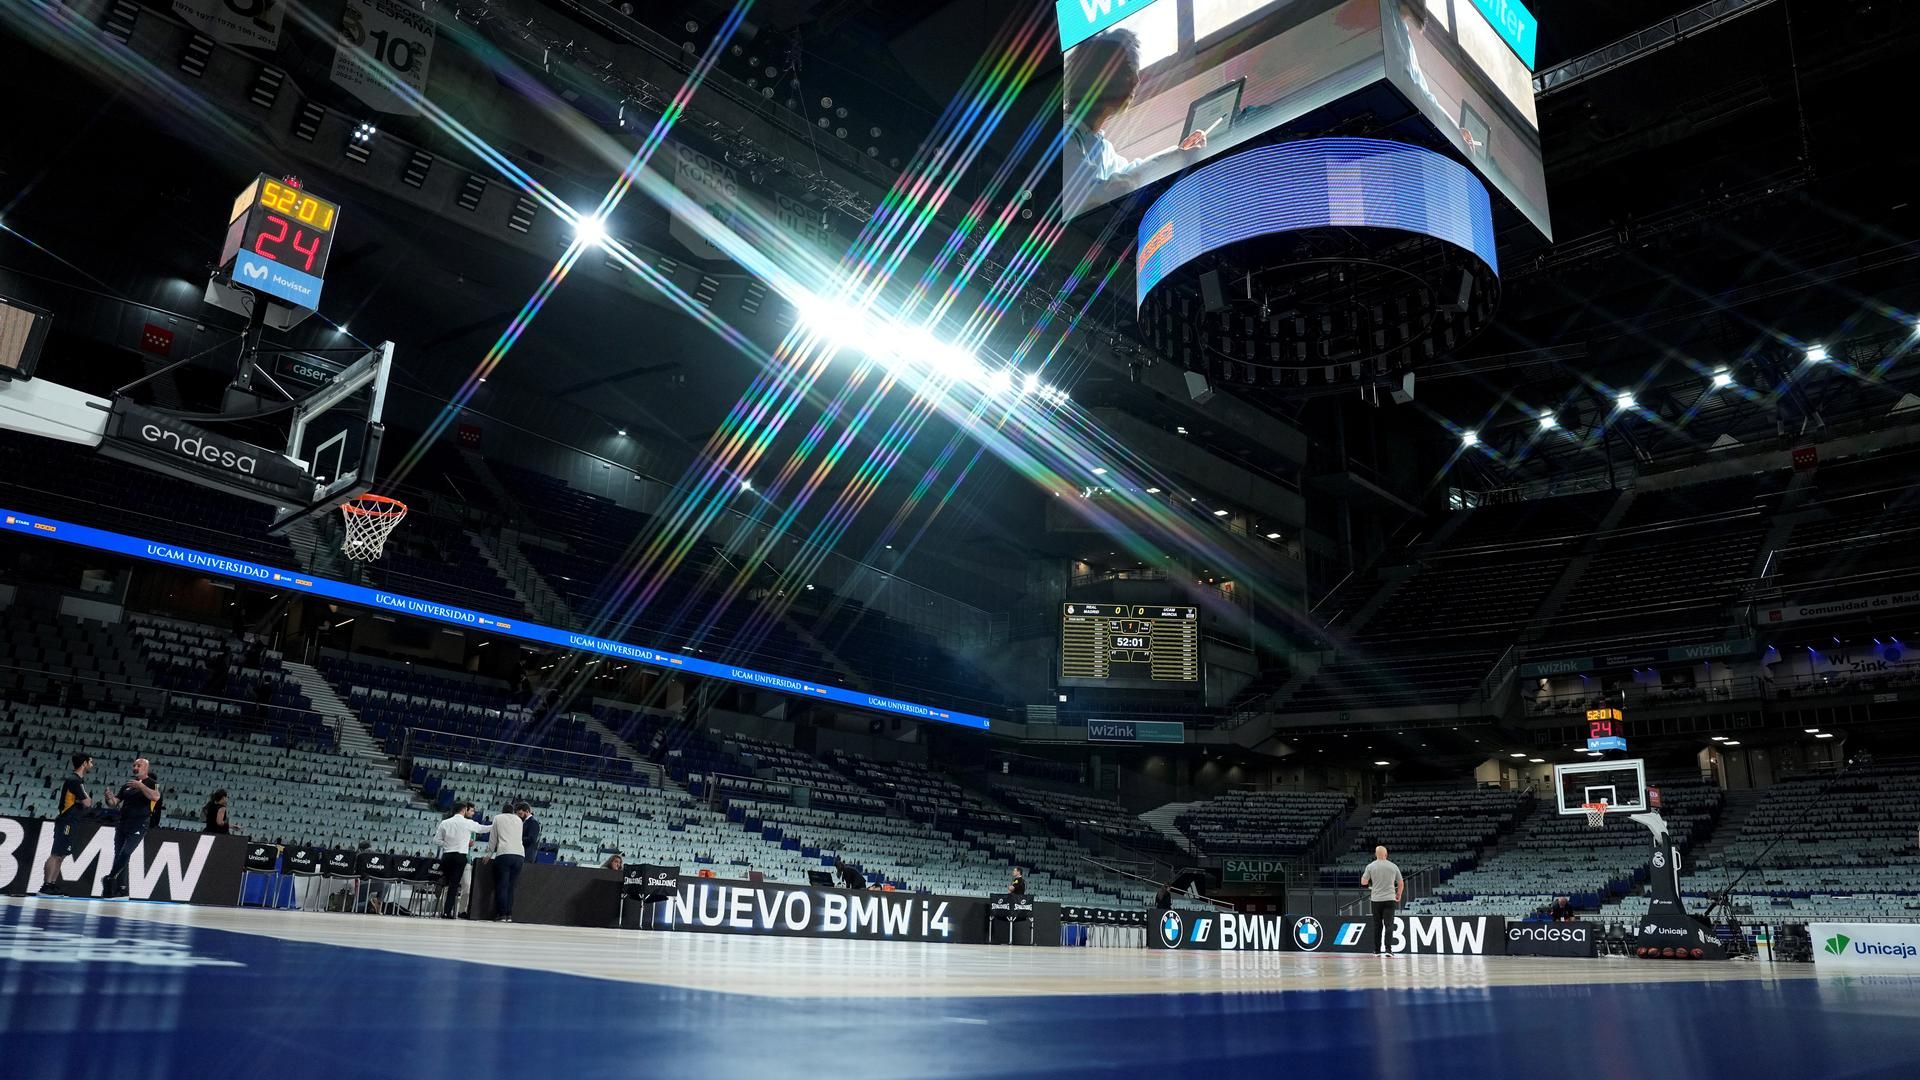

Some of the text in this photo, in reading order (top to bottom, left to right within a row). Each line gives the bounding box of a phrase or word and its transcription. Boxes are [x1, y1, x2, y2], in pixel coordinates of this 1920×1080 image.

[261, 182, 334, 228] 52:01
[255, 215, 320, 271] 24
[272, 274, 312, 296] Movistar
[293, 364, 327, 381] caser
[141, 424, 256, 474] endesa
[147, 545, 269, 579] UCAM UNIVERSIDAD
[375, 594, 475, 623] UCAM UNIVERSIDAD
[1114, 607, 1121, 615] 0
[1138, 607, 1145, 615] 0
[1799, 601, 1869, 616] Comunidad
[1872, 598, 1888, 607] de
[569, 635, 653, 660] UCAM UNIVERSIDAD
[1116, 637, 1144, 647] 52:01
[731, 669, 802, 690] UCAM UNIVERSIDAD
[868, 697, 928, 715] UCAM UNIVERSIDAD
[1587, 708, 1612, 721] 52:01
[1591, 721, 1612, 738] 24
[1226, 861, 1285, 873] SALIDA
[647, 877, 677, 888] SPALDING
[1243, 872, 1269, 881] EXIT
[664, 883, 949, 937] NUEVO BMW i4
[1219, 913, 1281, 950] BMW
[1509, 924, 1586, 942] endesa
[1658, 928, 1688, 936] Unicaja
[1855, 942, 1917, 959] Unicaja
